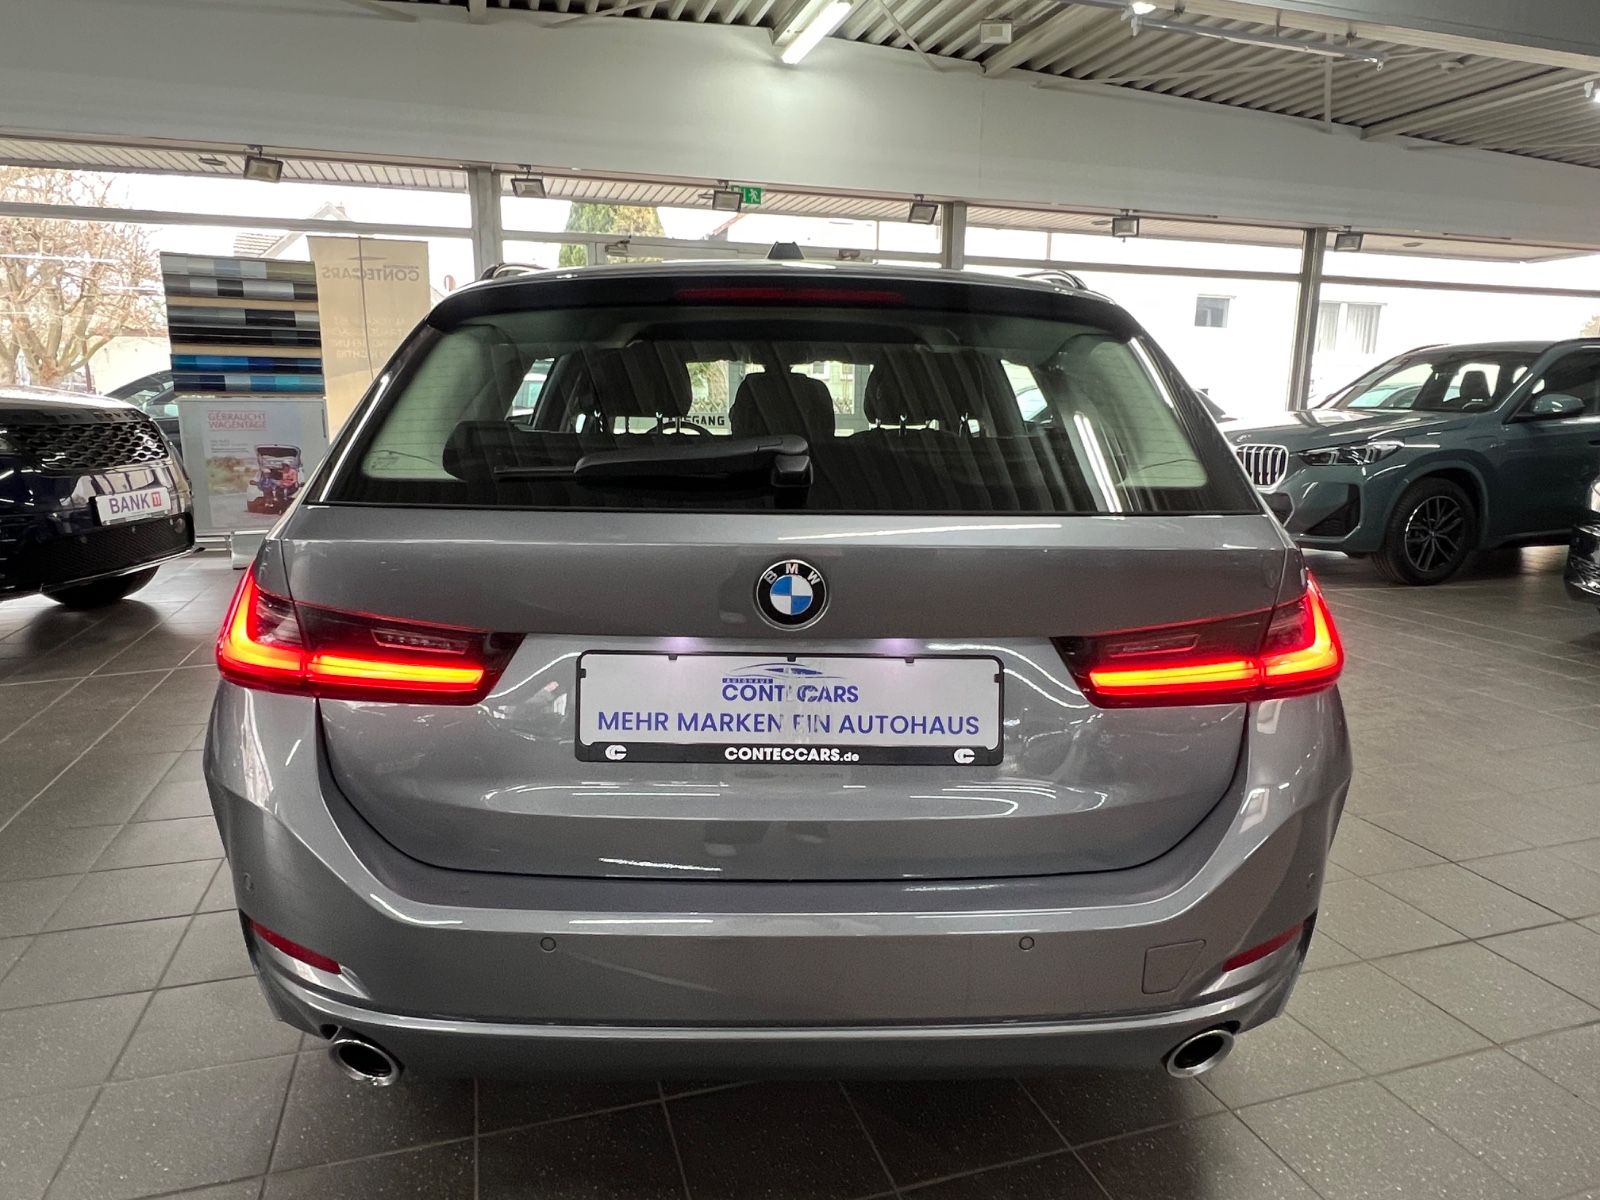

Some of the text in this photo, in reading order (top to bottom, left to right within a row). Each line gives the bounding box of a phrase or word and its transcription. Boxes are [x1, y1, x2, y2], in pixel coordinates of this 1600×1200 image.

[208, 413, 266, 421] GEBRAUCHT
[109, 494, 150, 514] BANK
[764, 563, 820, 585] BMW
[598, 711, 669, 732] MEHR
[677, 712, 784, 733] MARKEN
[838, 714, 980, 735] AUTOHAUS
[724, 747, 860, 762] CONTECCARS.de
